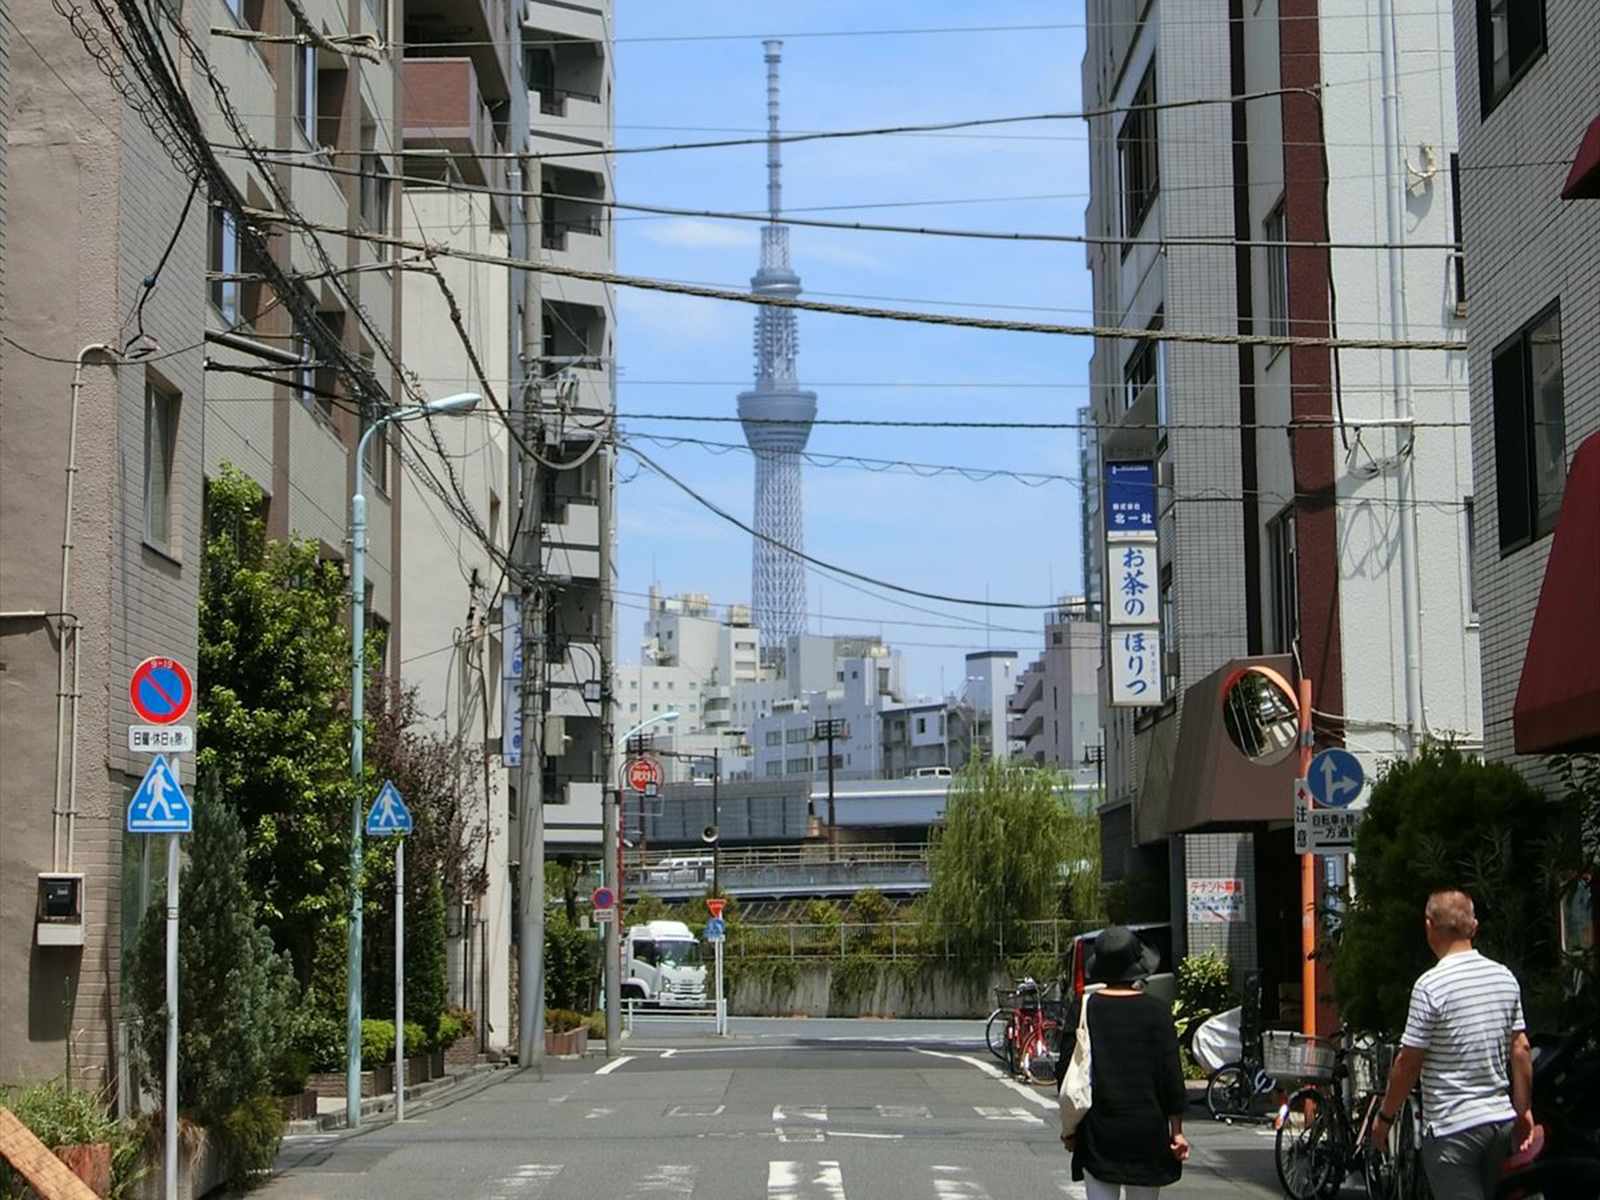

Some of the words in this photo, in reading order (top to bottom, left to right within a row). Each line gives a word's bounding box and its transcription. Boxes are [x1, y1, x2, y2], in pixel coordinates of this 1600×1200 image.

[1121, 546, 1149, 616] お茶の
[1125, 632, 1147, 696] ほりつ
[1296, 805, 1308, 848] 注意
